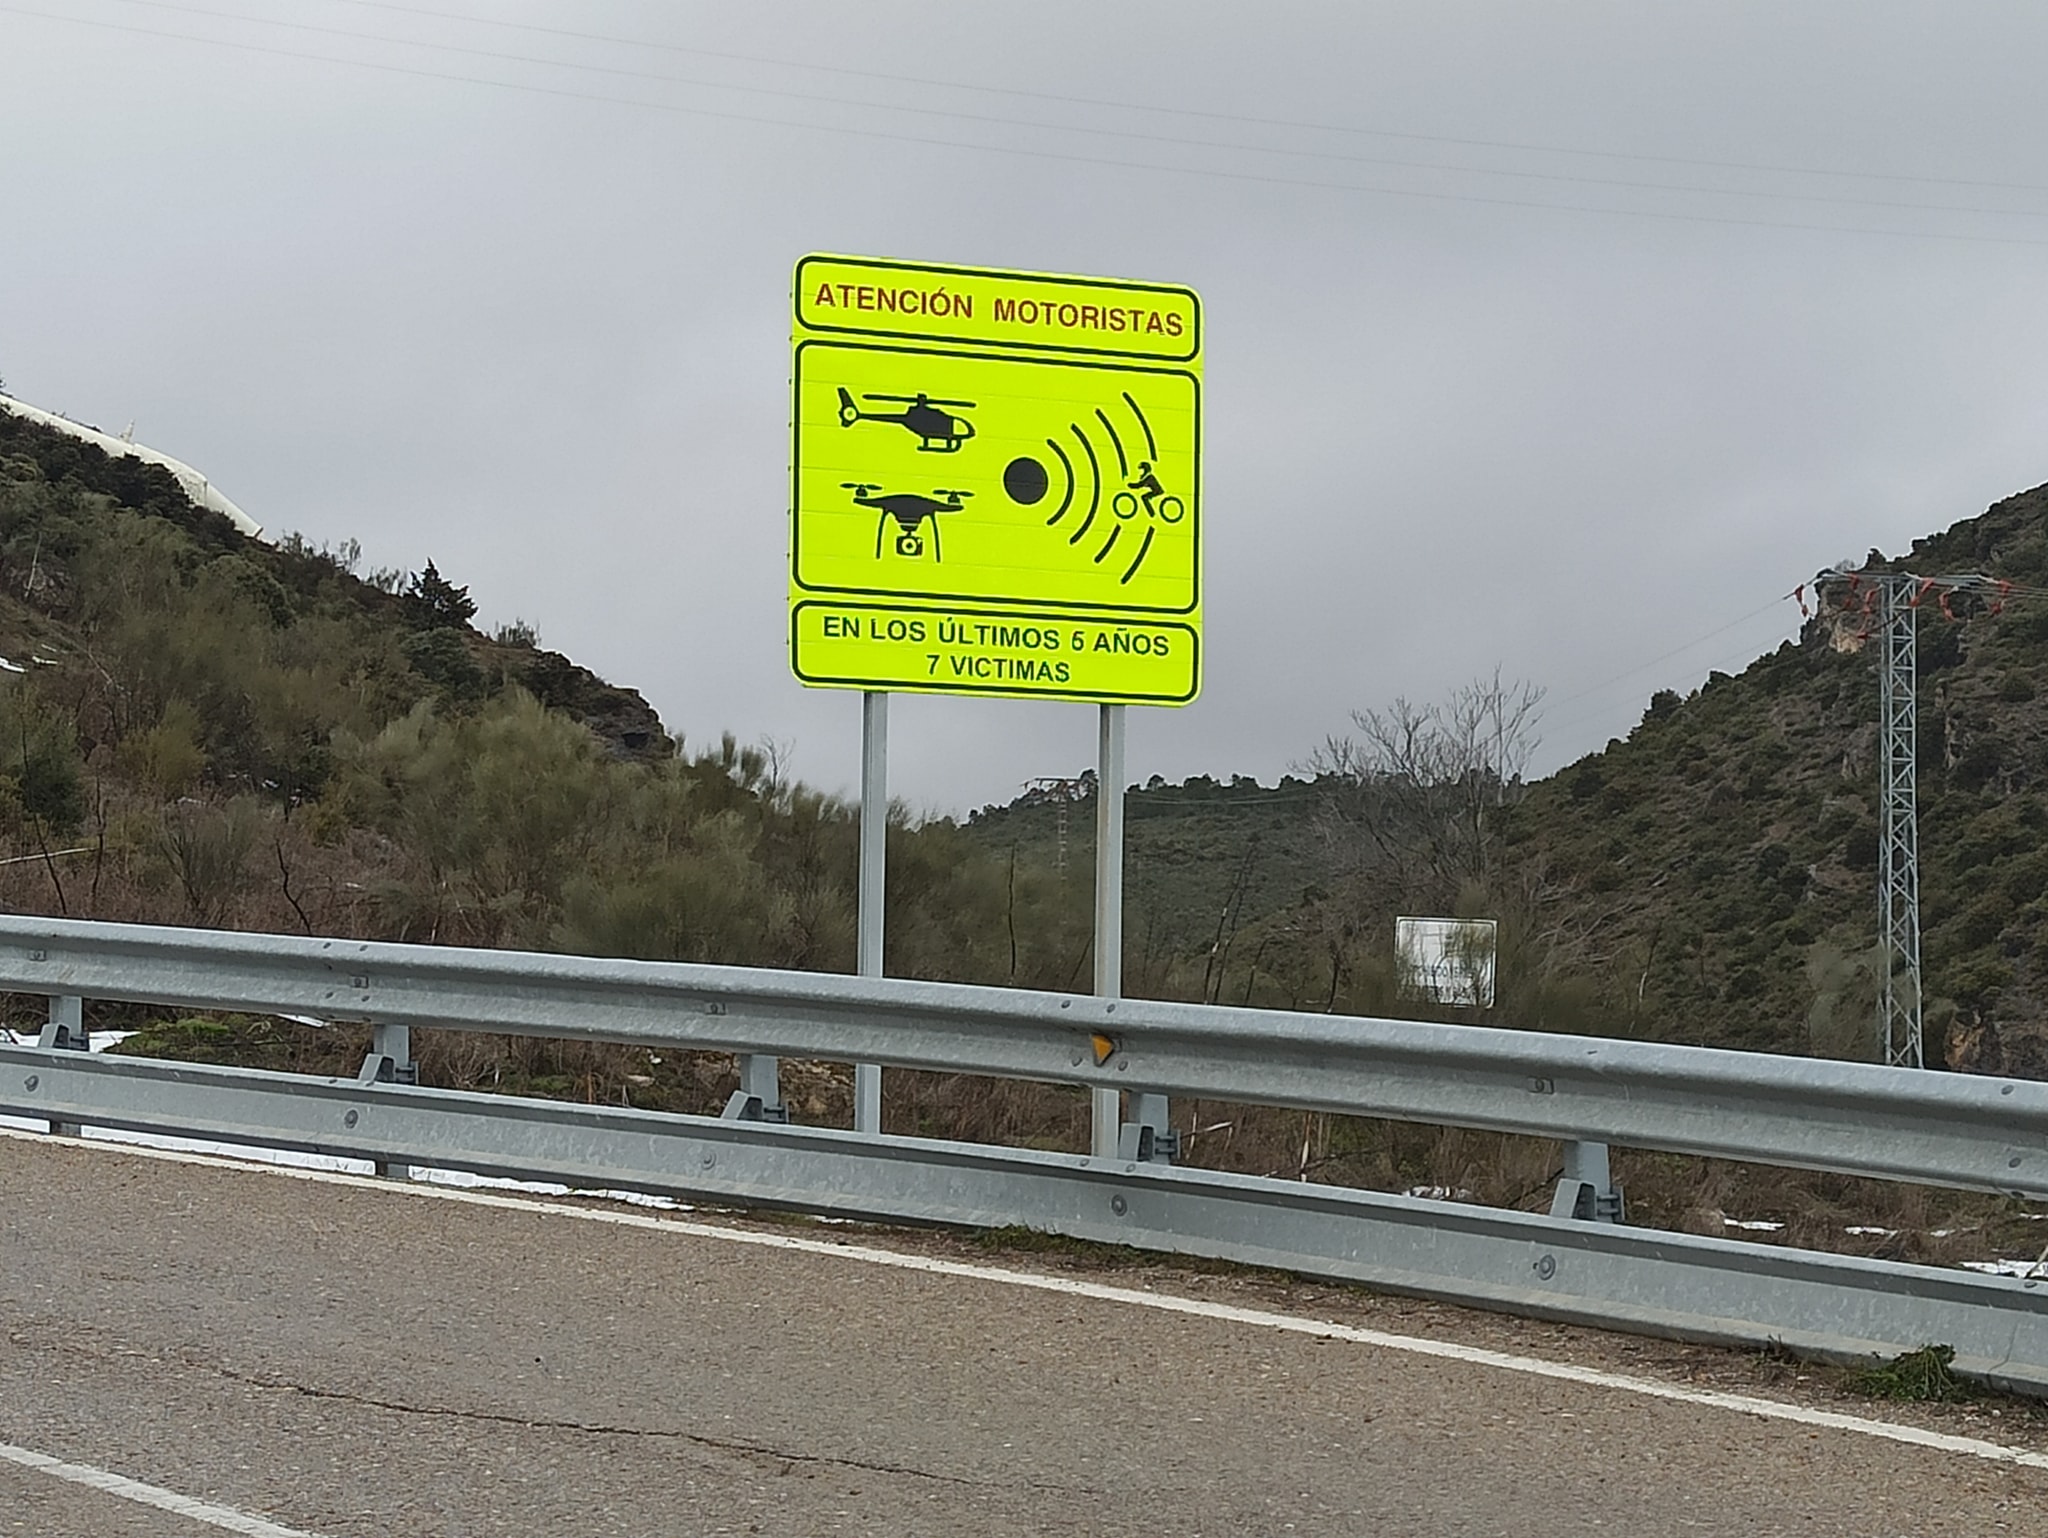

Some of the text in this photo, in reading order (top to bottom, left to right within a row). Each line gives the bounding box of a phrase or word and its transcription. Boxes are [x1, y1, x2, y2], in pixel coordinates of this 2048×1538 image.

[815, 283, 1183, 337] ATENCIÓN MOTORISTAS
[823, 615, 860, 639] EN
[870, 618, 926, 642] LOS
[938, 616, 1060, 650] ÚLTIMOS
[1092, 627, 1170, 657] AÑOS
[926, 654, 1070, 683] 7 VICTIMAS
